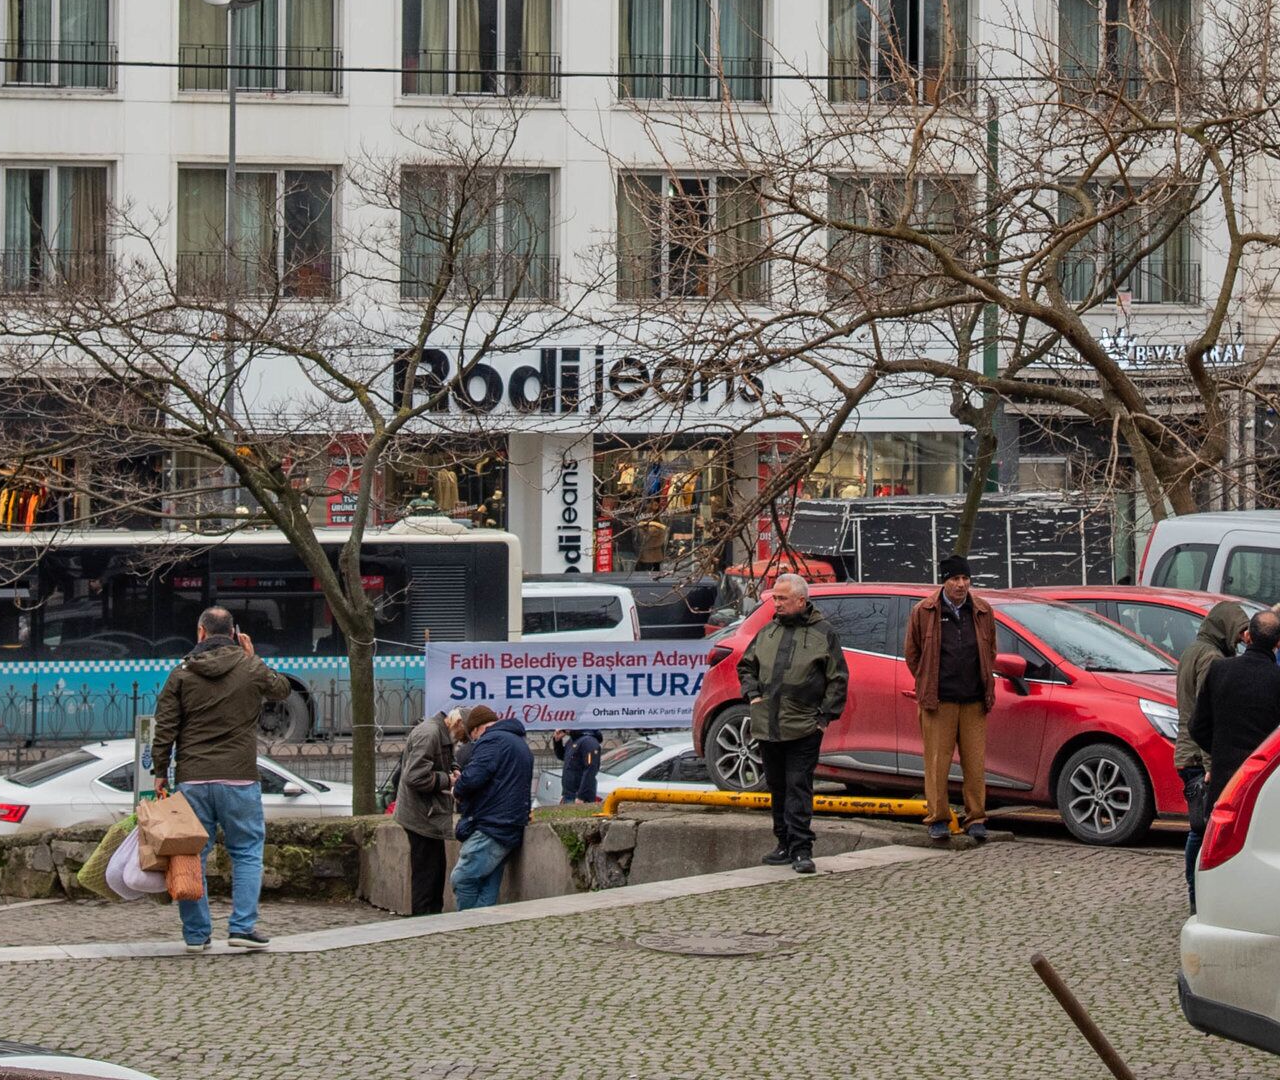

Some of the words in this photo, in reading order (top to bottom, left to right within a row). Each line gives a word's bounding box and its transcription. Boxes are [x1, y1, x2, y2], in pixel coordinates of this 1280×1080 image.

[450, 653, 495, 670] Fatih
[500, 651, 577, 672] Belediye
[582, 651, 647, 671] Başkan
[450, 676, 494, 700] Sn.
[506, 673, 617, 699] ERGÜN
[522, 703, 578, 723] Olsun
[592, 707, 620, 716] Orhan
[621, 707, 646, 716] Narin
